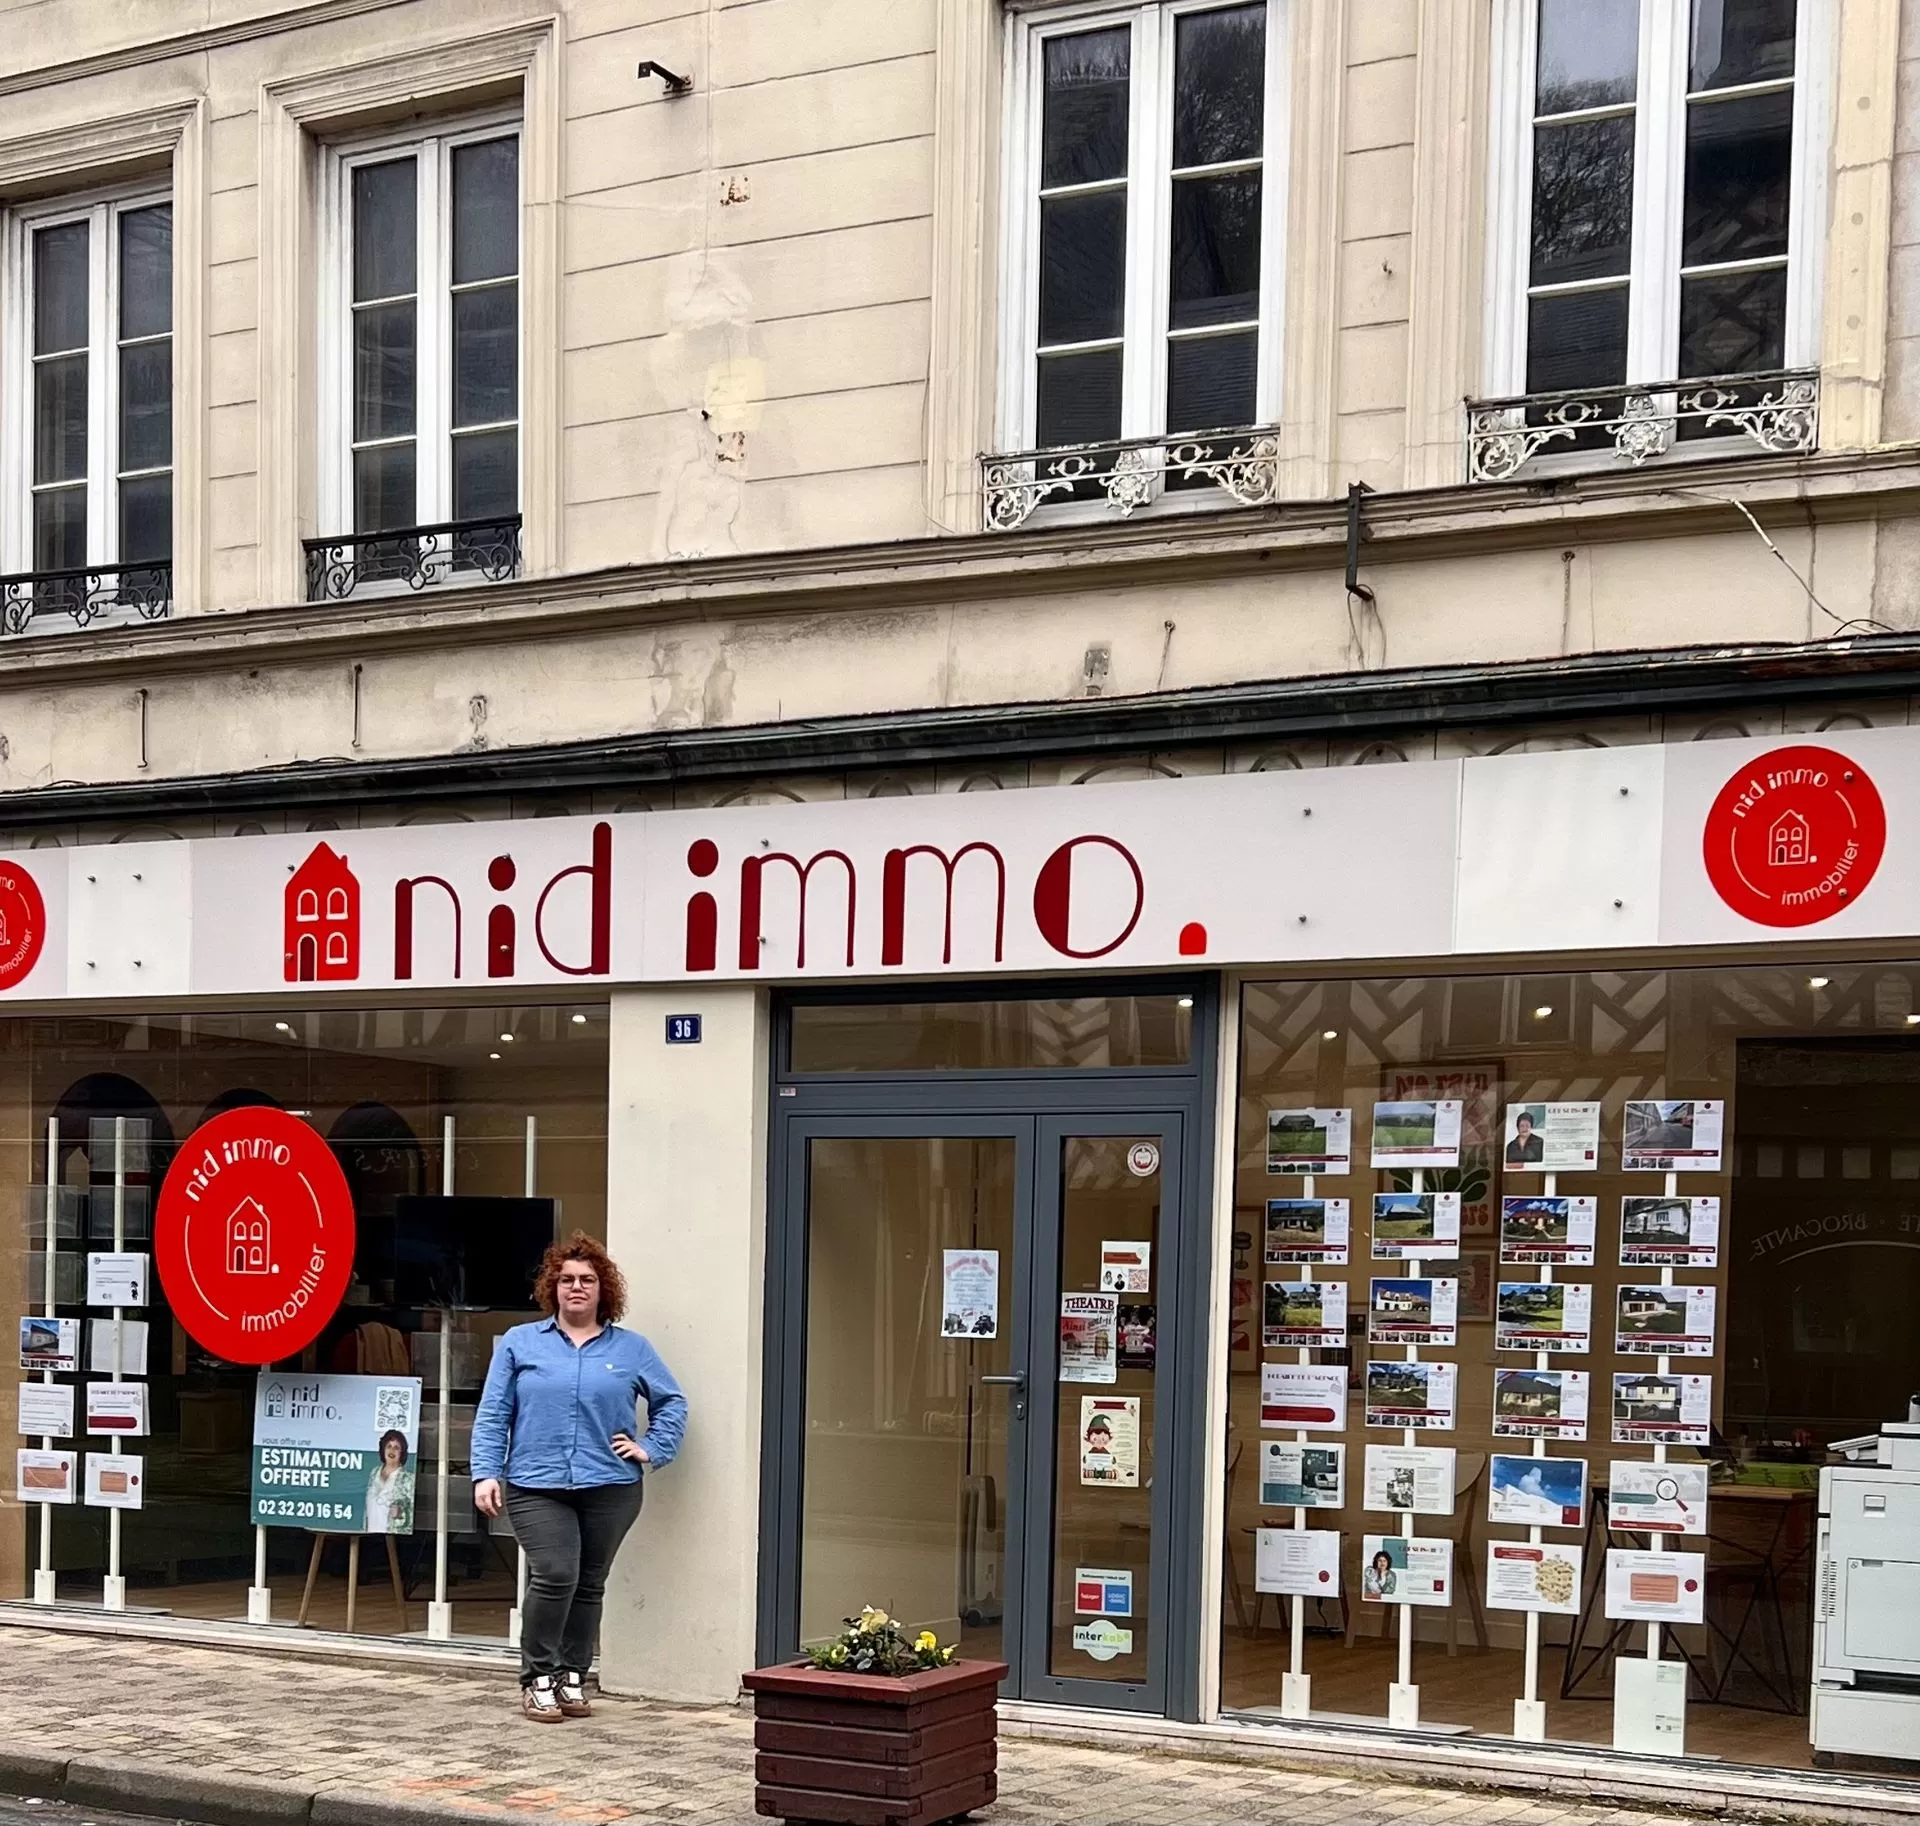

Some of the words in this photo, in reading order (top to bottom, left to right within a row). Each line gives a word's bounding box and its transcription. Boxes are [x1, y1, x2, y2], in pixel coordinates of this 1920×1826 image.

[1732, 780, 1765, 818] nid
[1766, 768, 1829, 790] immo
[1781, 839, 1860, 906] immobilier
[395, 825, 611, 980] nid
[675, 1019, 692, 1039] 36
[185, 1149, 221, 1202] nid
[222, 1137, 291, 1166] immo
[241, 1242, 327, 1333] immobilier
[1064, 1296, 1115, 1310] THEATRE
[292, 1383, 320, 1402] nid
[261, 1436, 279, 1444] vous
[261, 1448, 363, 1470] ESTIMATION
[260, 1467, 330, 1488] OFFERTE
[258, 1499, 276, 1515] 02
[277, 1500, 295, 1516] 32
[296, 1501, 315, 1518] 20
[316, 1502, 332, 1519] 16
[333, 1504, 353, 1520] 54
